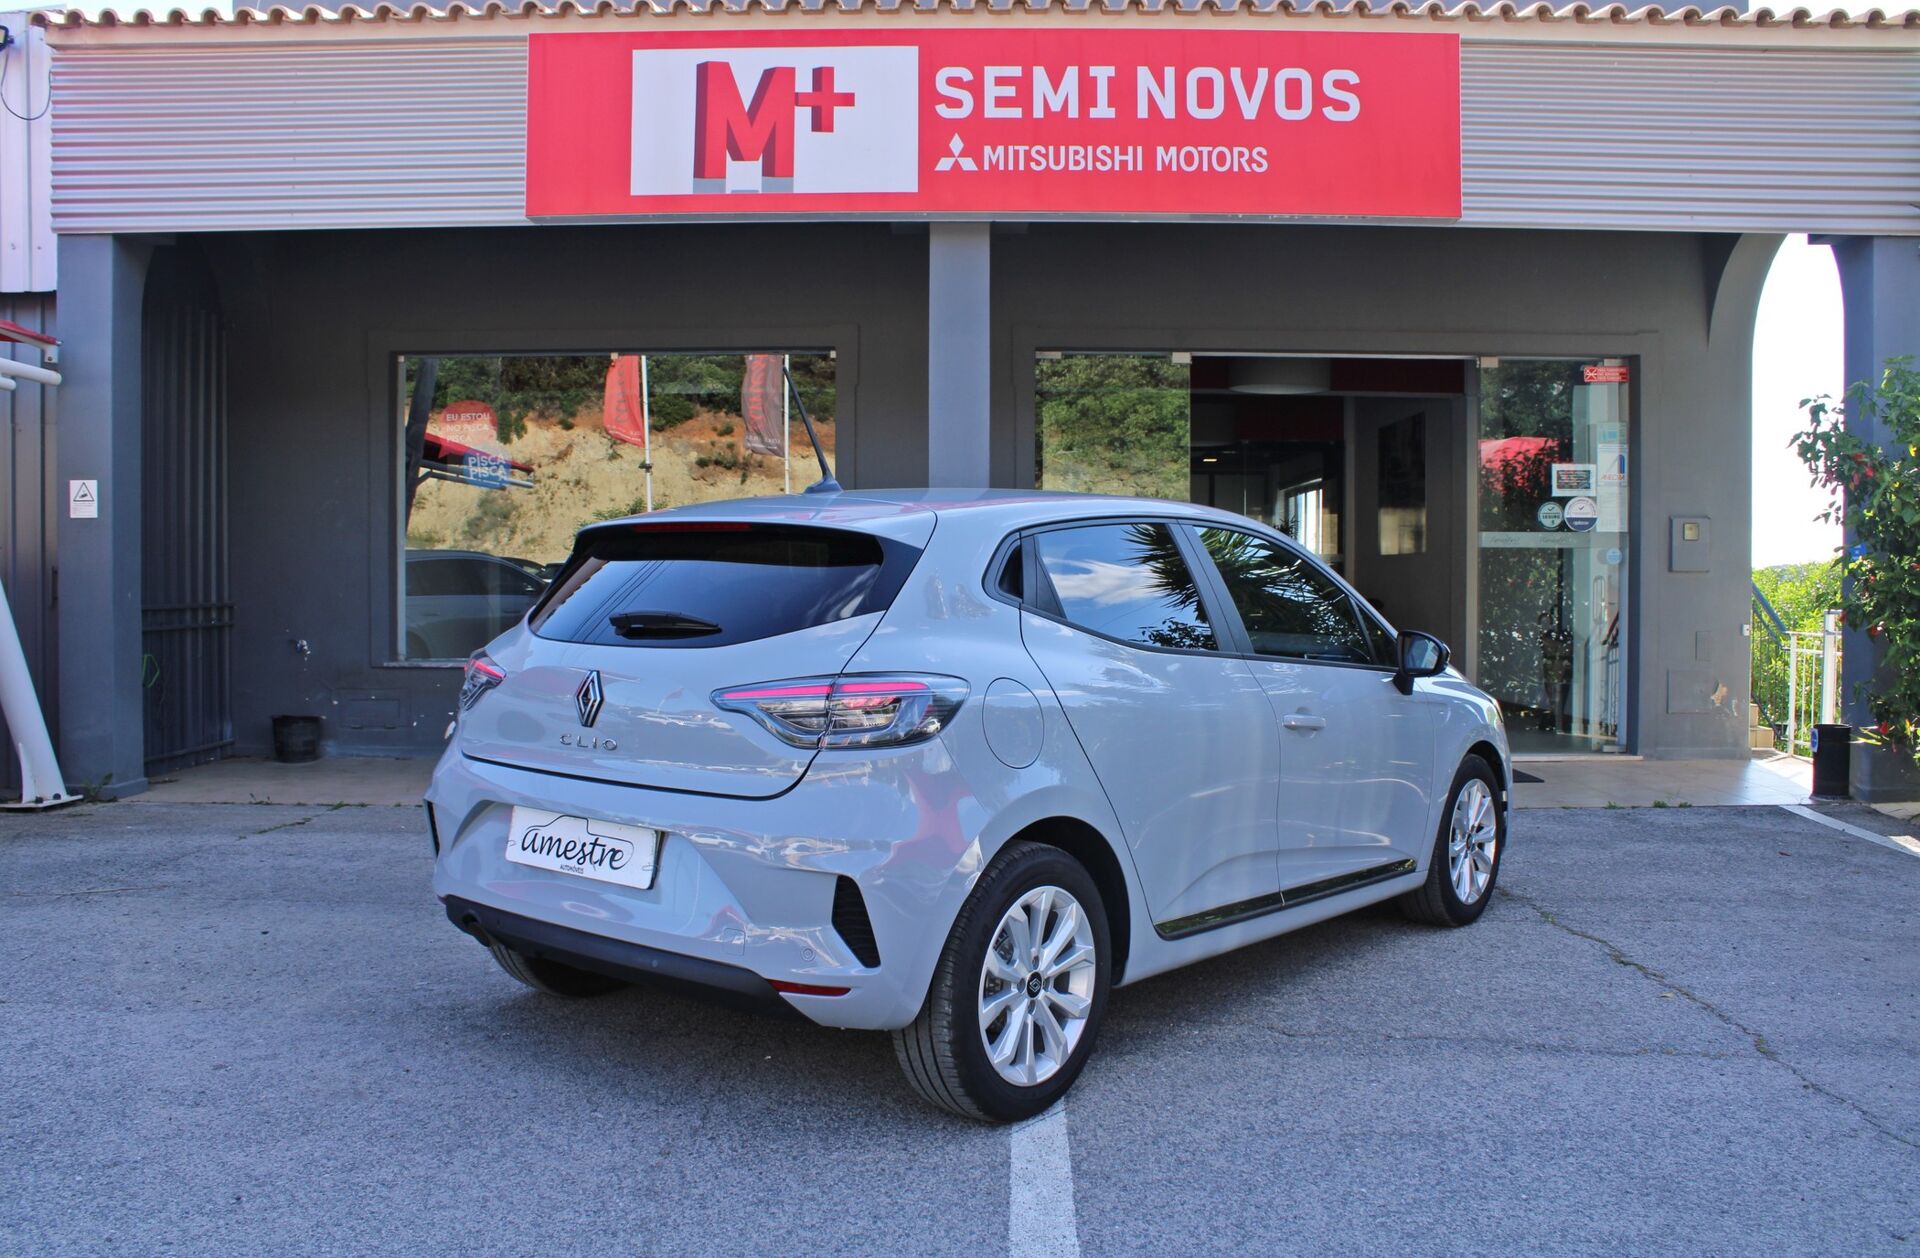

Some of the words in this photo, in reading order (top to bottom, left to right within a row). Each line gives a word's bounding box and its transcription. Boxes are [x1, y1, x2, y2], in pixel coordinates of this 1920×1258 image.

[934, 65, 1116, 119] SEMI
[1136, 65, 1361, 122] NOVOS
[983, 144, 1143, 172] MITSUBISHI
[1156, 145, 1269, 173] MOTORS
[446, 413, 458, 422] EU
[460, 412, 490, 421] ESTOU
[559, 733, 618, 751] CLIO
[521, 828, 625, 871] amestre
